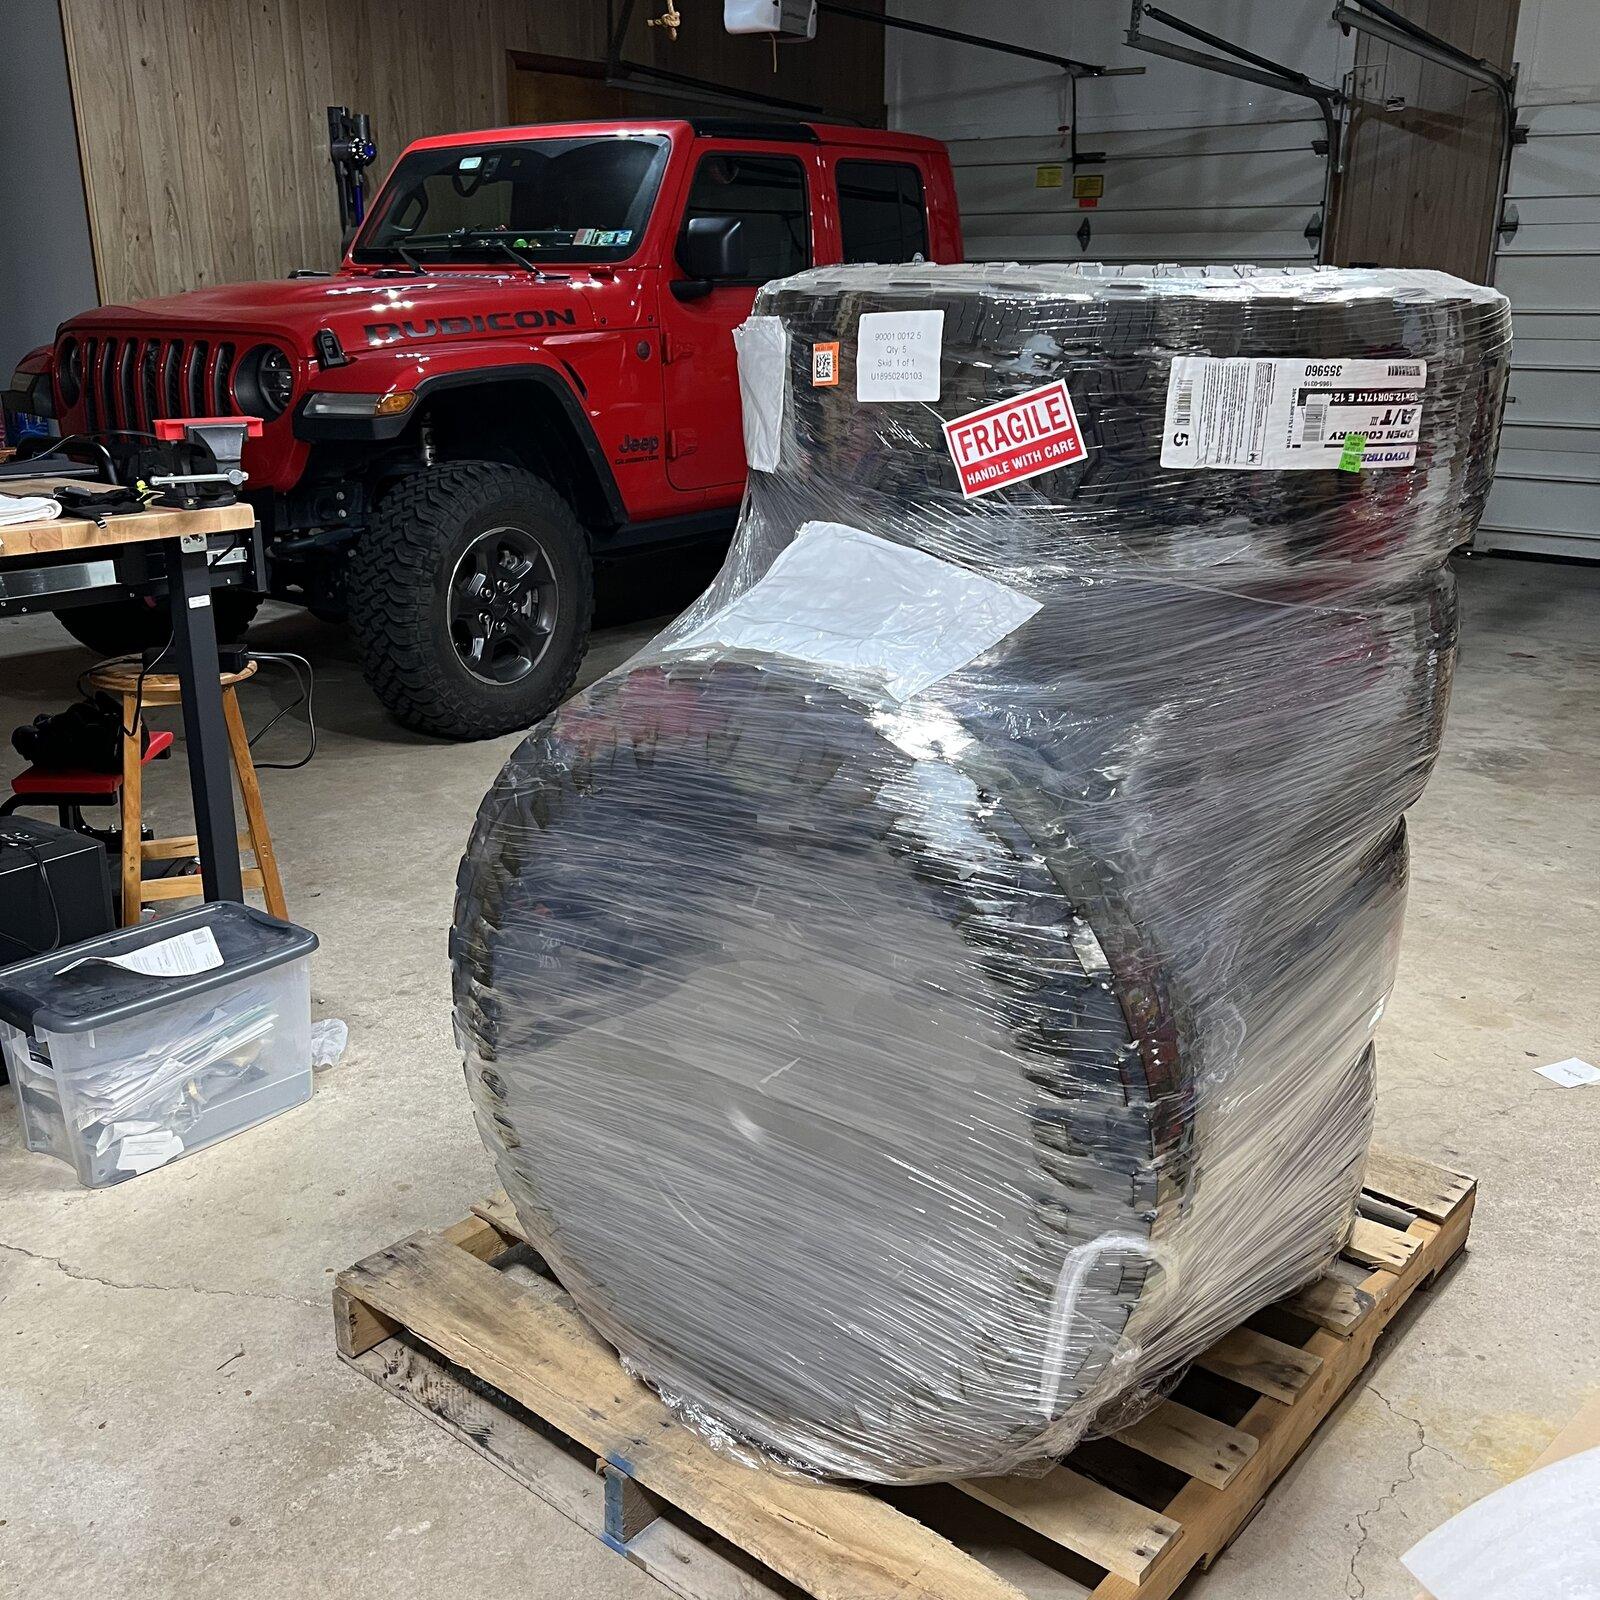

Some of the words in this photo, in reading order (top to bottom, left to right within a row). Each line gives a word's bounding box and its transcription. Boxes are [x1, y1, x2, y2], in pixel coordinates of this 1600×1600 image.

[364, 308, 576, 346] RUBICON
[916, 331, 922, 340] 5
[902, 345, 907, 353] 5
[902, 358, 910, 367] of
[1304, 365, 1342, 376] 355960
[1348, 393, 1355, 402] E
[1379, 409, 1417, 426] A/T
[957, 397, 1066, 462] FRAGILE
[1386, 430, 1414, 439] OPEN
[618, 434, 659, 454] Jeep
[1173, 432, 1190, 447] 5
[966, 460, 1011, 486] HANDLE
[1011, 450, 1042, 470] WITH
[1045, 438, 1076, 459] CARE
